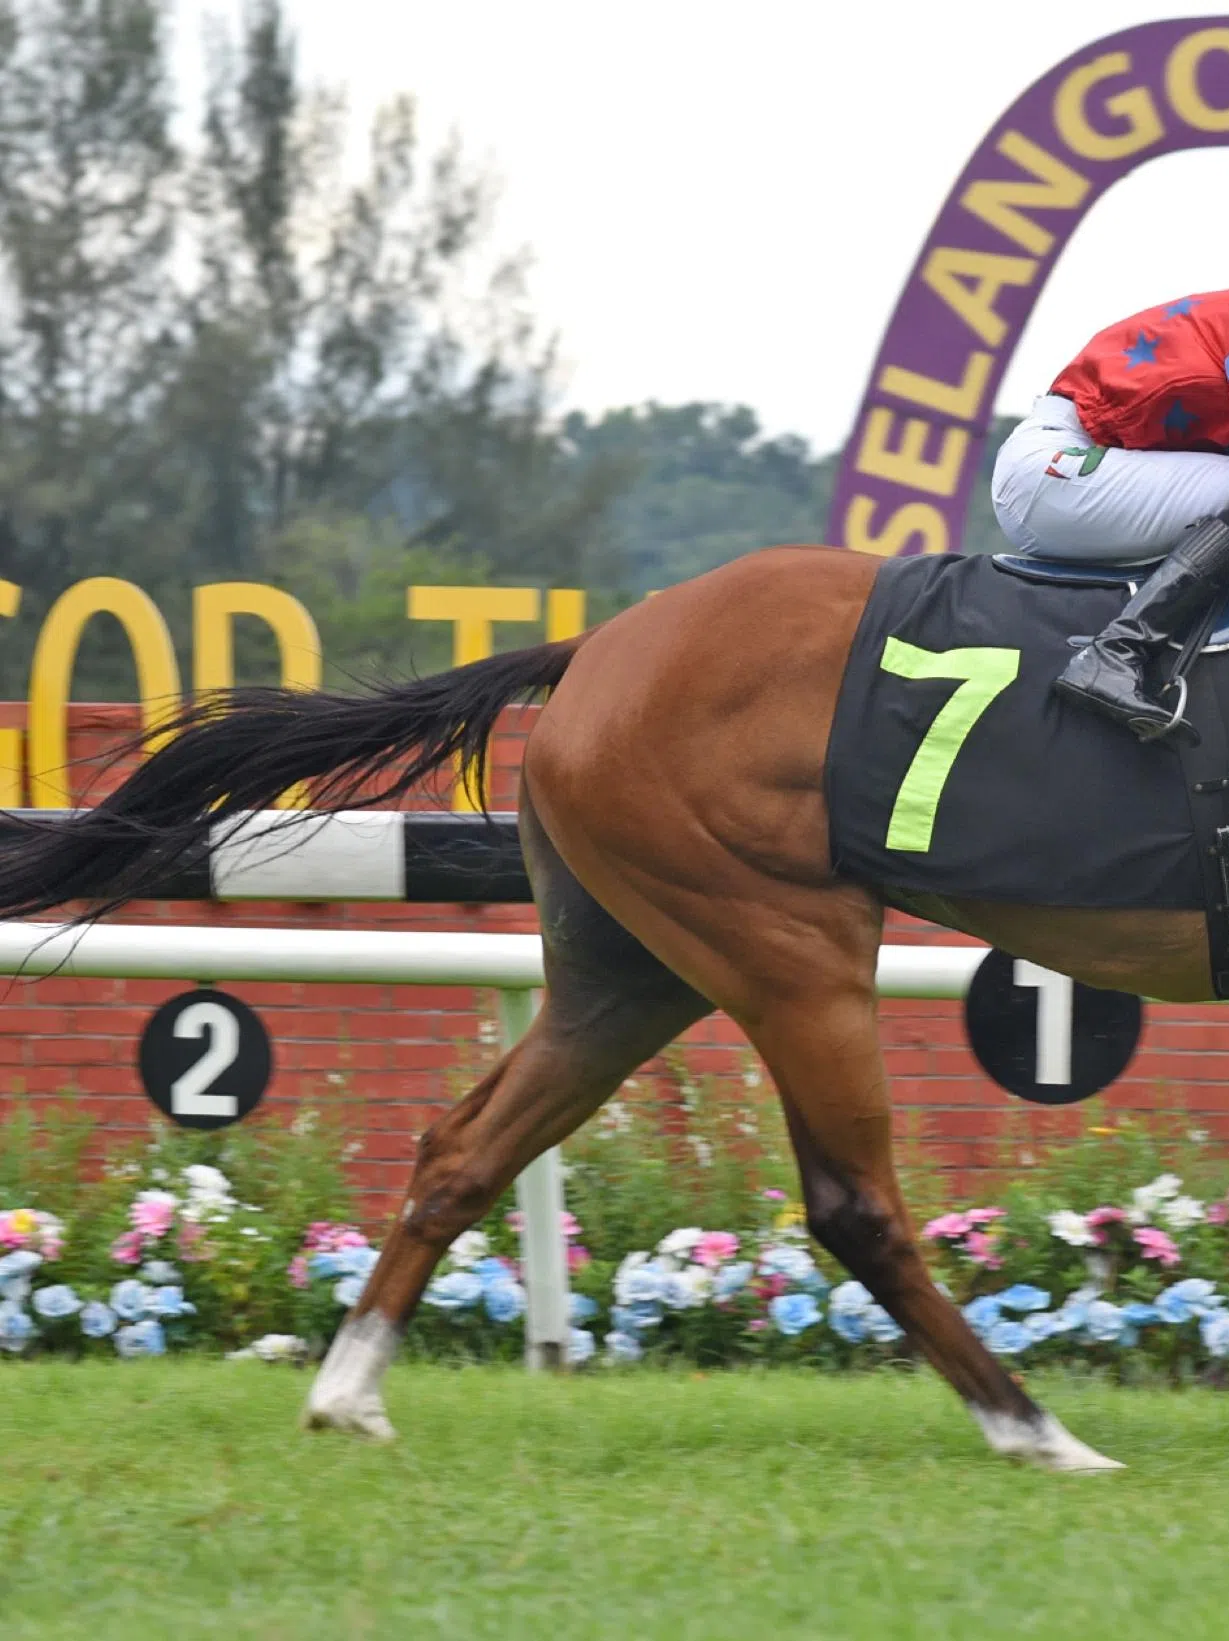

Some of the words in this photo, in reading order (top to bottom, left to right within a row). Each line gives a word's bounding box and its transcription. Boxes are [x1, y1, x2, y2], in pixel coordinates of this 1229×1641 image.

[880, 636, 1020, 853] 7
[171, 1002, 240, 1116] 2
[1013, 959, 1073, 1085] 1
